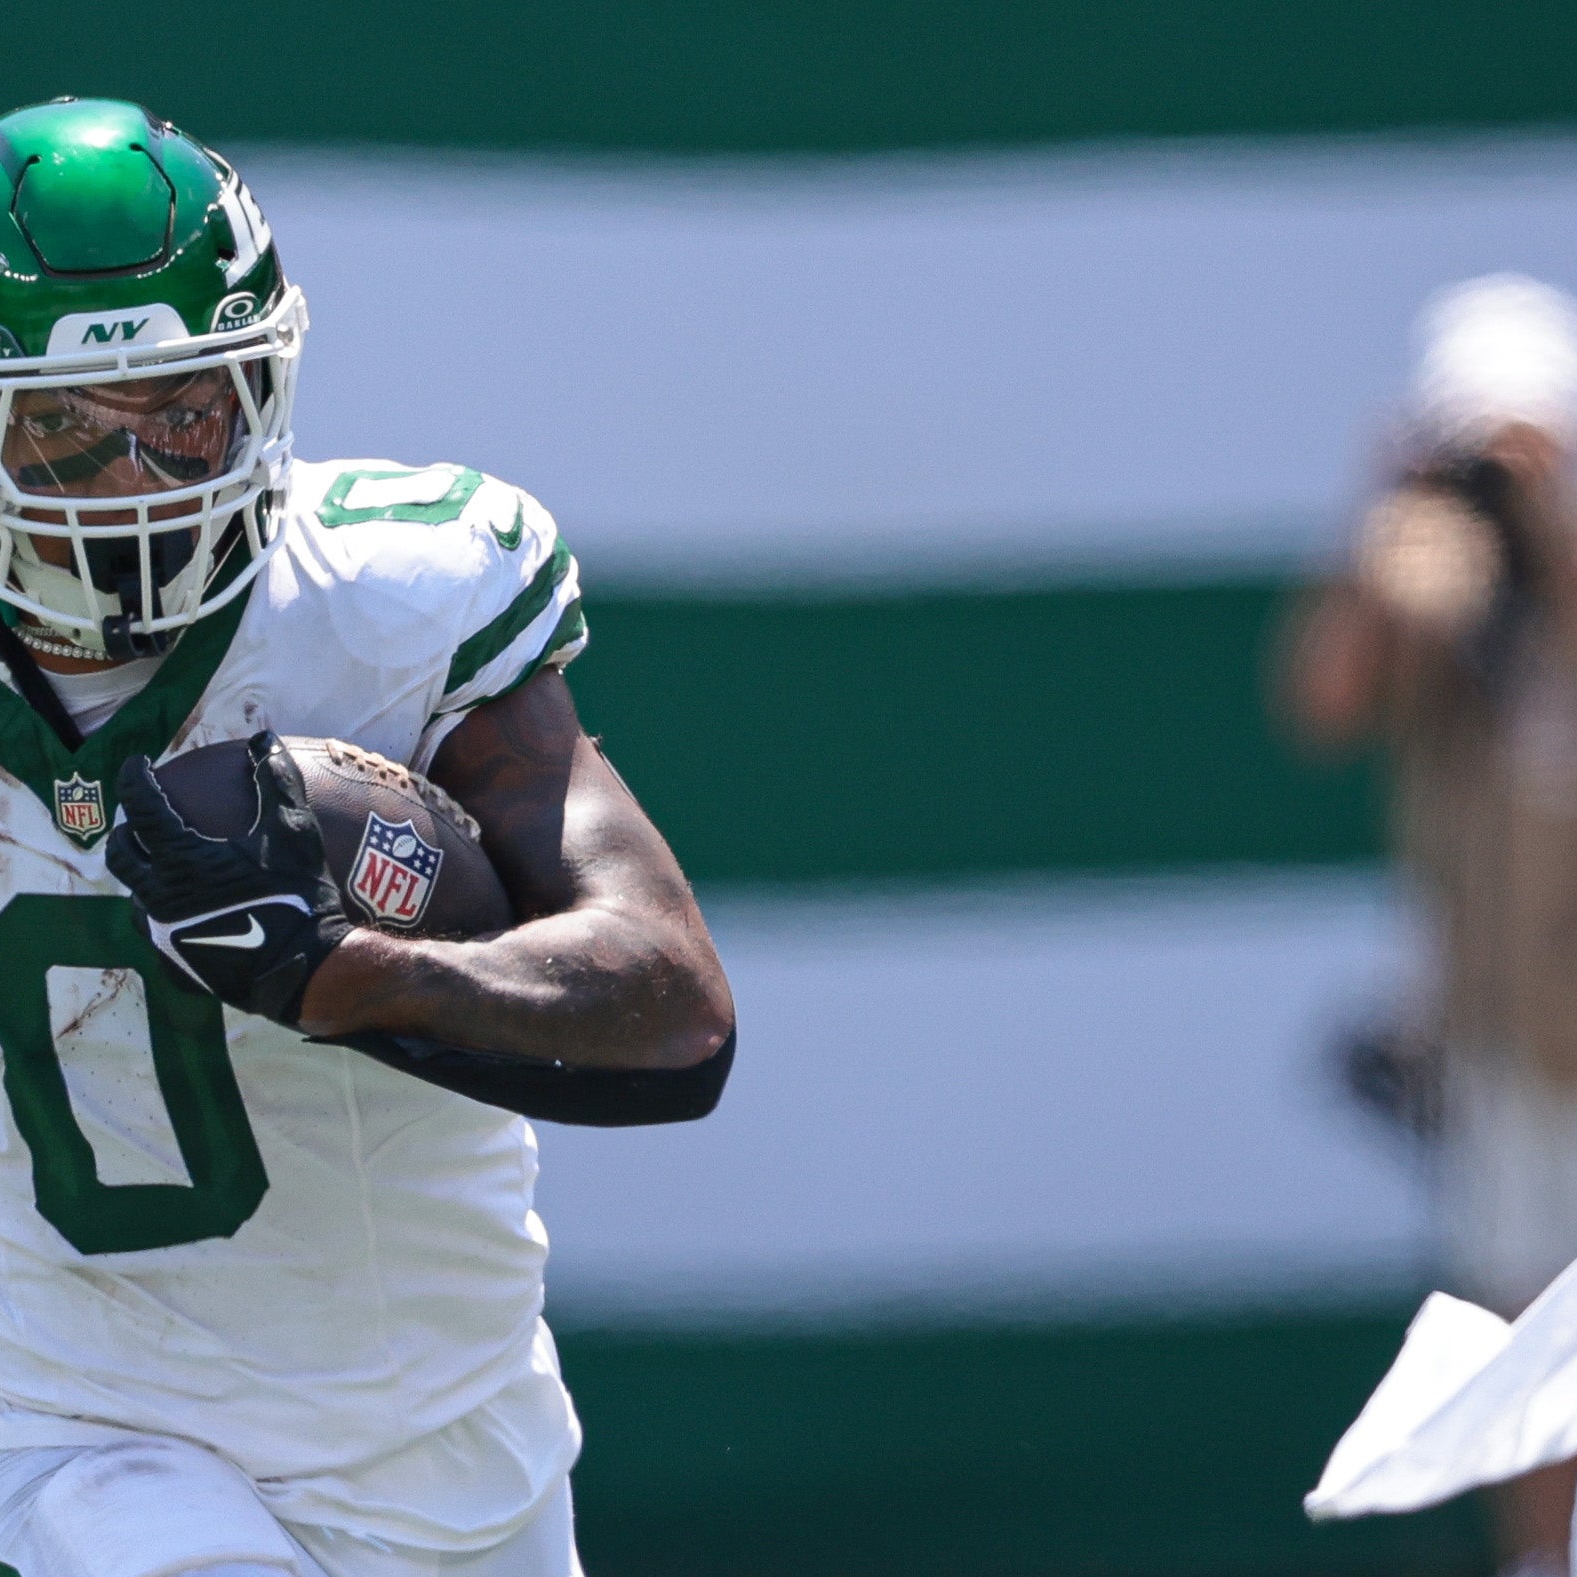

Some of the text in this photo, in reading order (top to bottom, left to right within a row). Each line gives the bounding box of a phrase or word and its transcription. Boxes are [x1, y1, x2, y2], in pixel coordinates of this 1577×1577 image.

[80, 317, 151, 345] NY
[62, 803, 100, 829] NFL
[357, 850, 423, 918] NFL
